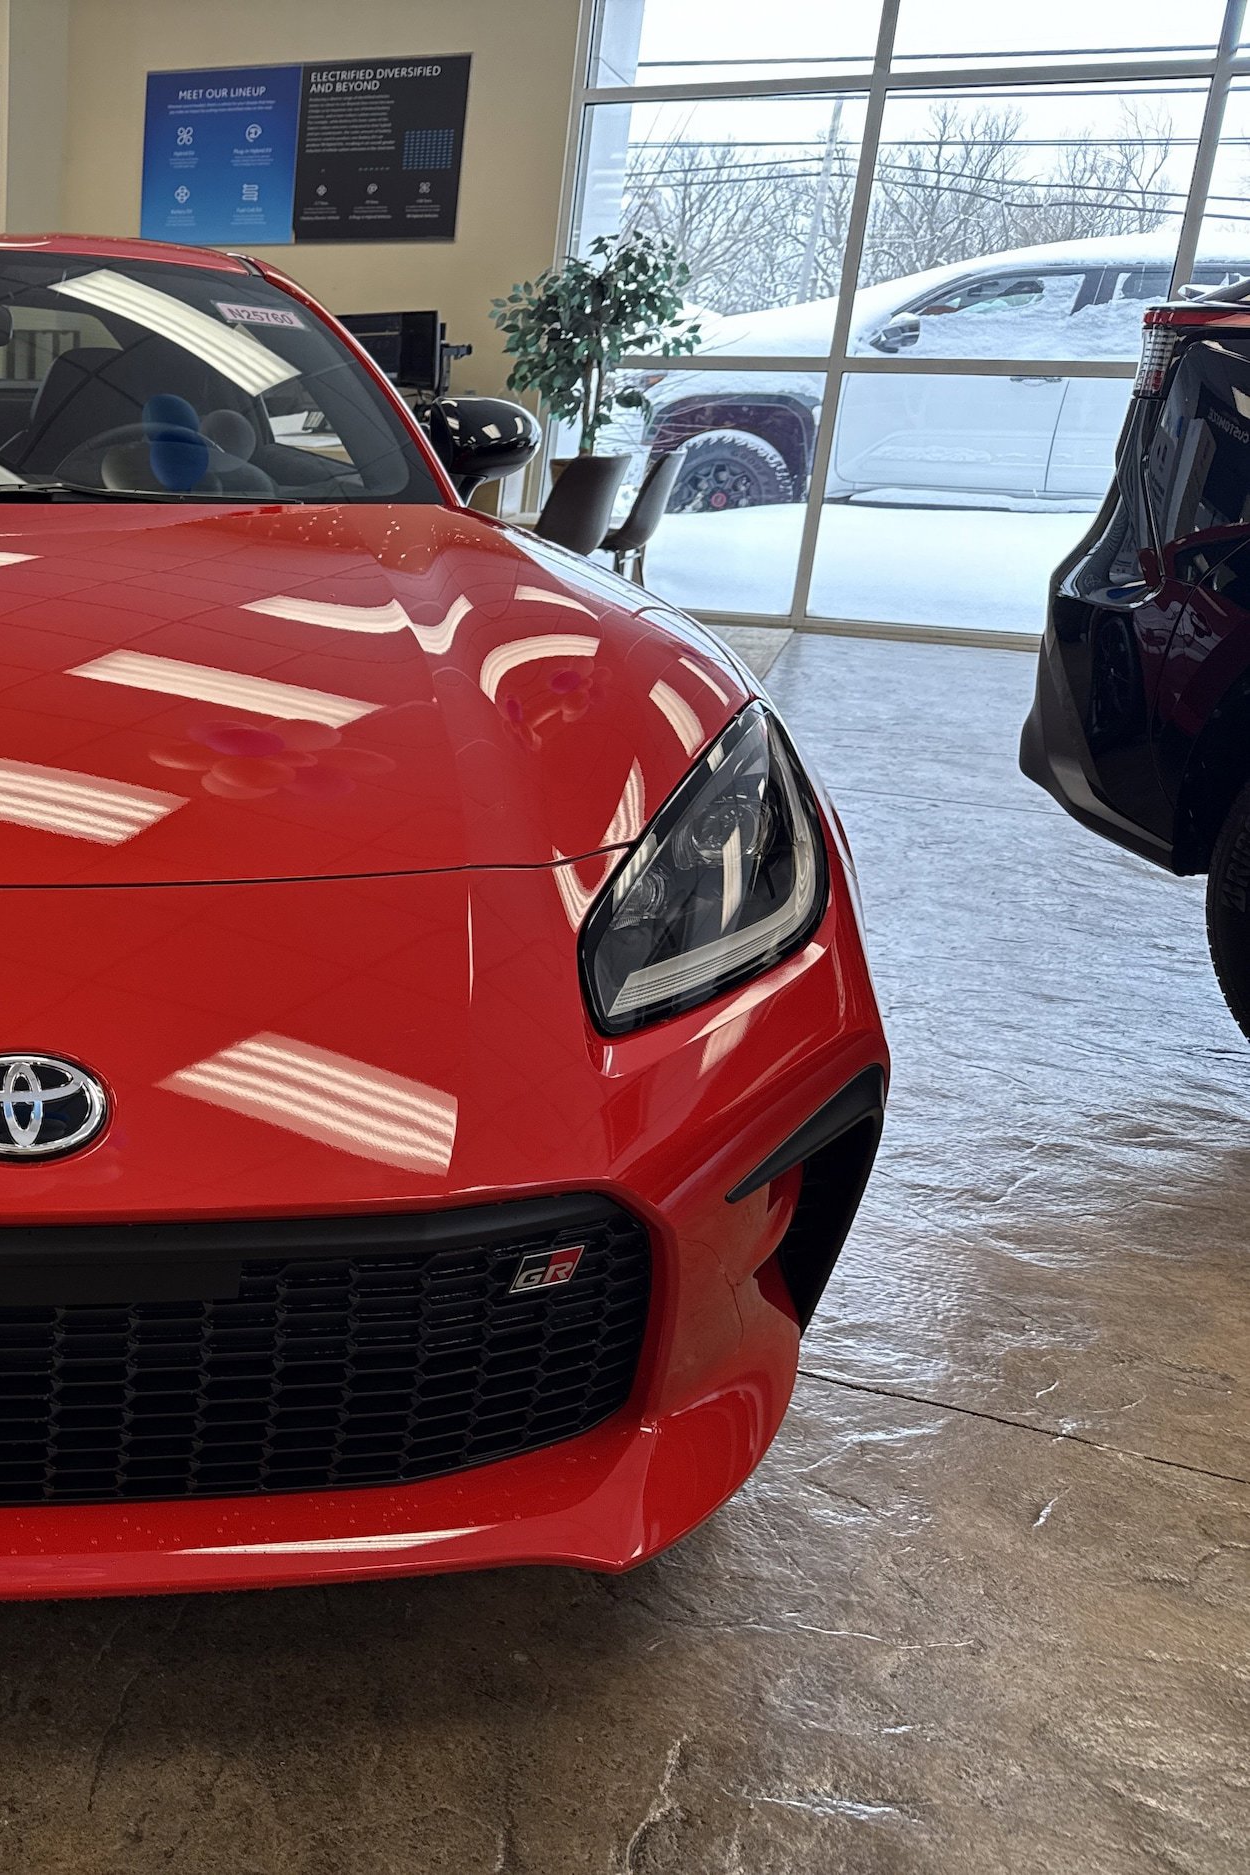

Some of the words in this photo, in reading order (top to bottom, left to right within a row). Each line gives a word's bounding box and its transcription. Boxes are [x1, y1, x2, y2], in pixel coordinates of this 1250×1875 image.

[310, 69, 374, 82] ELECTRIFIED
[376, 65, 442, 79] DIVERSIFIED
[178, 89, 203, 100] MEET
[205, 88, 228, 99] OUR
[230, 86, 266, 97] LINEUP
[309, 83, 333, 93] AND
[335, 80, 380, 92] BEYOND
[227, 307, 294, 325] N25760
[515, 1261, 574, 1288] GR
